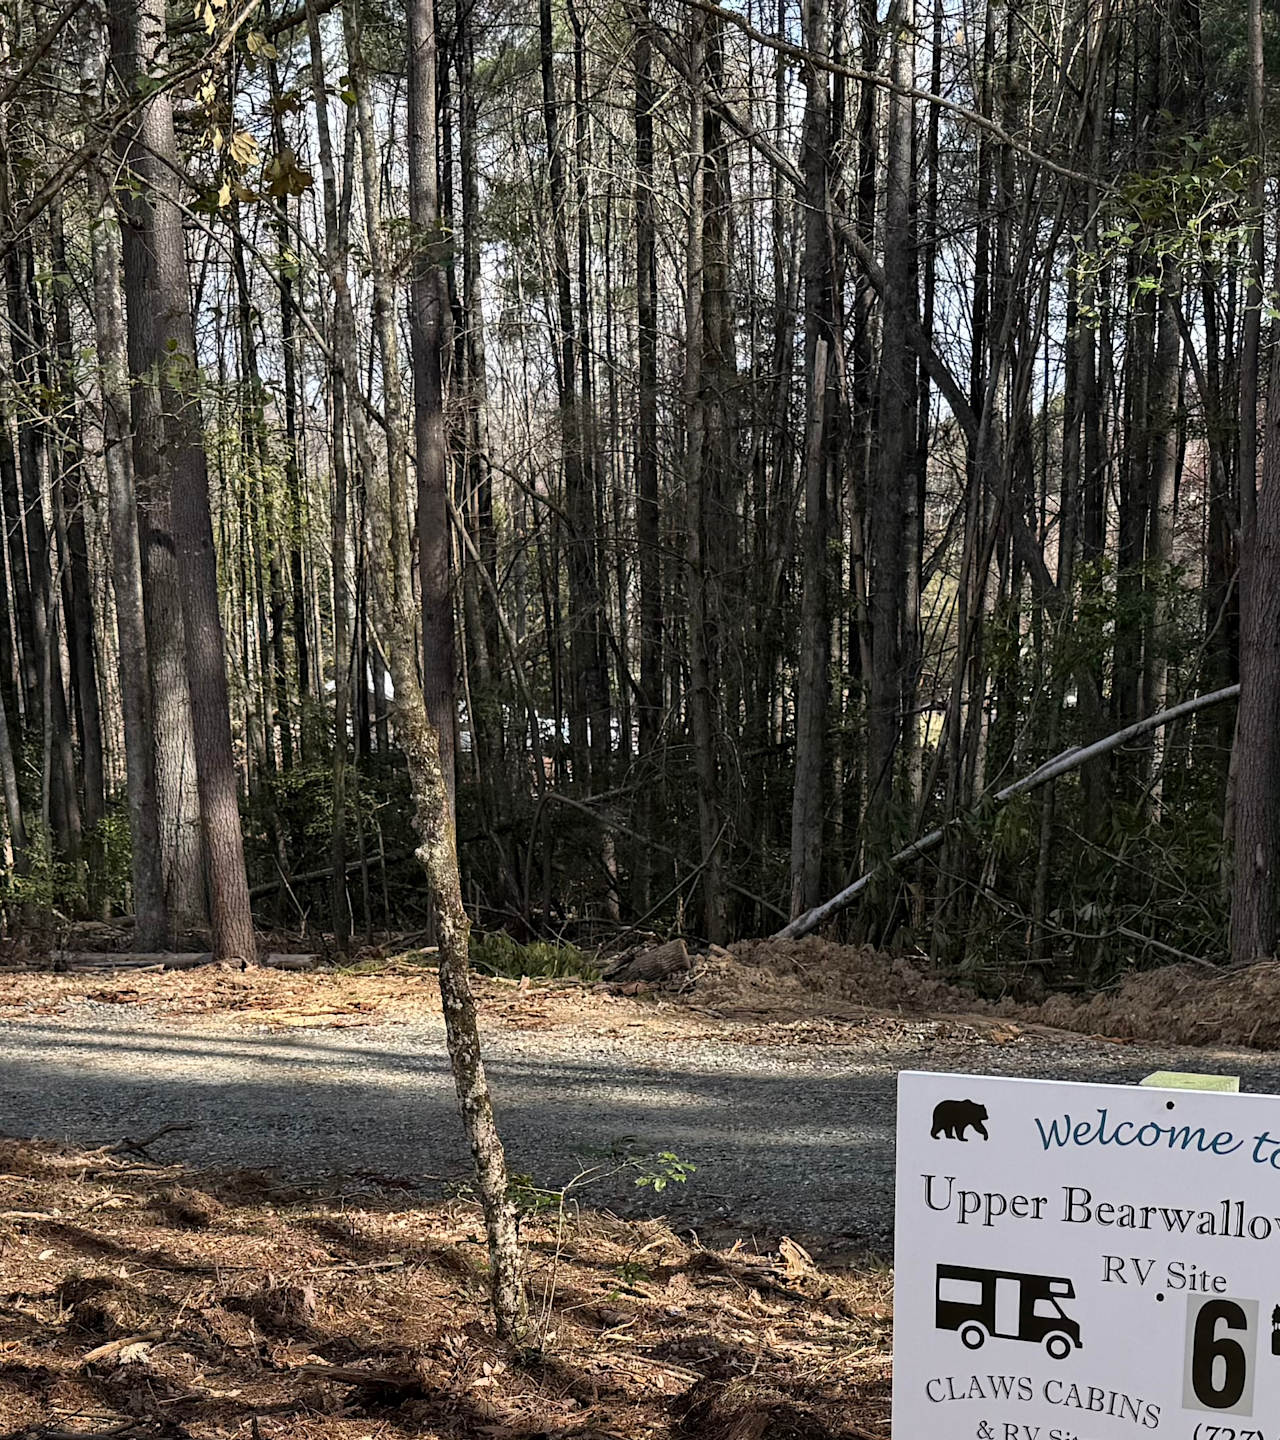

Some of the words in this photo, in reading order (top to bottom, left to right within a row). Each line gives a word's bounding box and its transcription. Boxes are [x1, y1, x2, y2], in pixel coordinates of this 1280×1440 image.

[1033, 1108, 1245, 1156] Welcome
[919, 1173, 1048, 1228] Upper
[1100, 1254, 1157, 1286] RV
[1166, 1261, 1228, 1294] Site
[1191, 1298, 1248, 1410] 6
[925, 1375, 1034, 1404] CLAWS
[1042, 1379, 1162, 1430] CABINS
[975, 1419, 995, 1440] &
